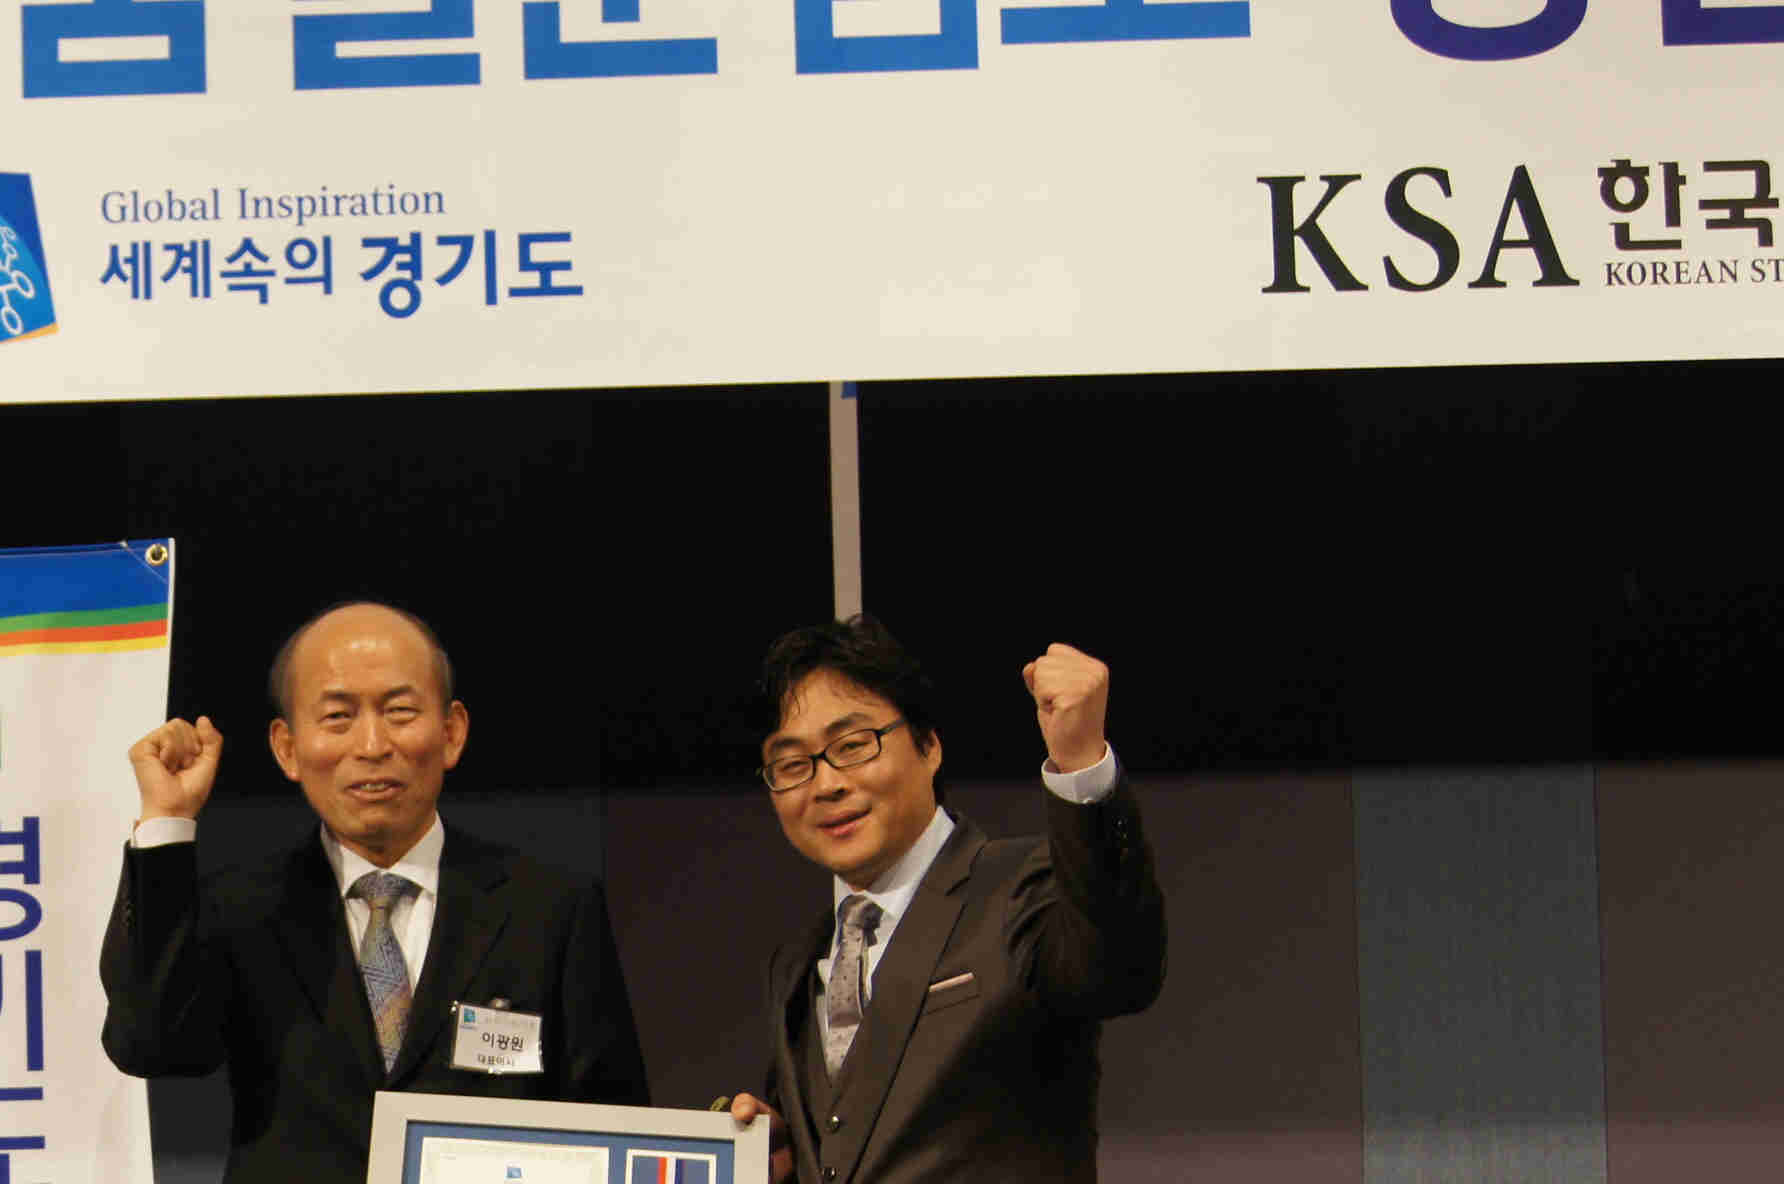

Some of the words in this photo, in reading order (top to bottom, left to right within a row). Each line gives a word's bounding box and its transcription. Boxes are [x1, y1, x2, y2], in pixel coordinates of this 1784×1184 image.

[101, 187, 221, 224] Global
[238, 184, 448, 226] Inspiration
[1256, 163, 1581, 294] KSA
[1597, 158, 1780, 251] 한국
[100, 234, 333, 305] 세계속의
[359, 229, 584, 319] 경기도
[1604, 259, 1738, 286] KOREAN
